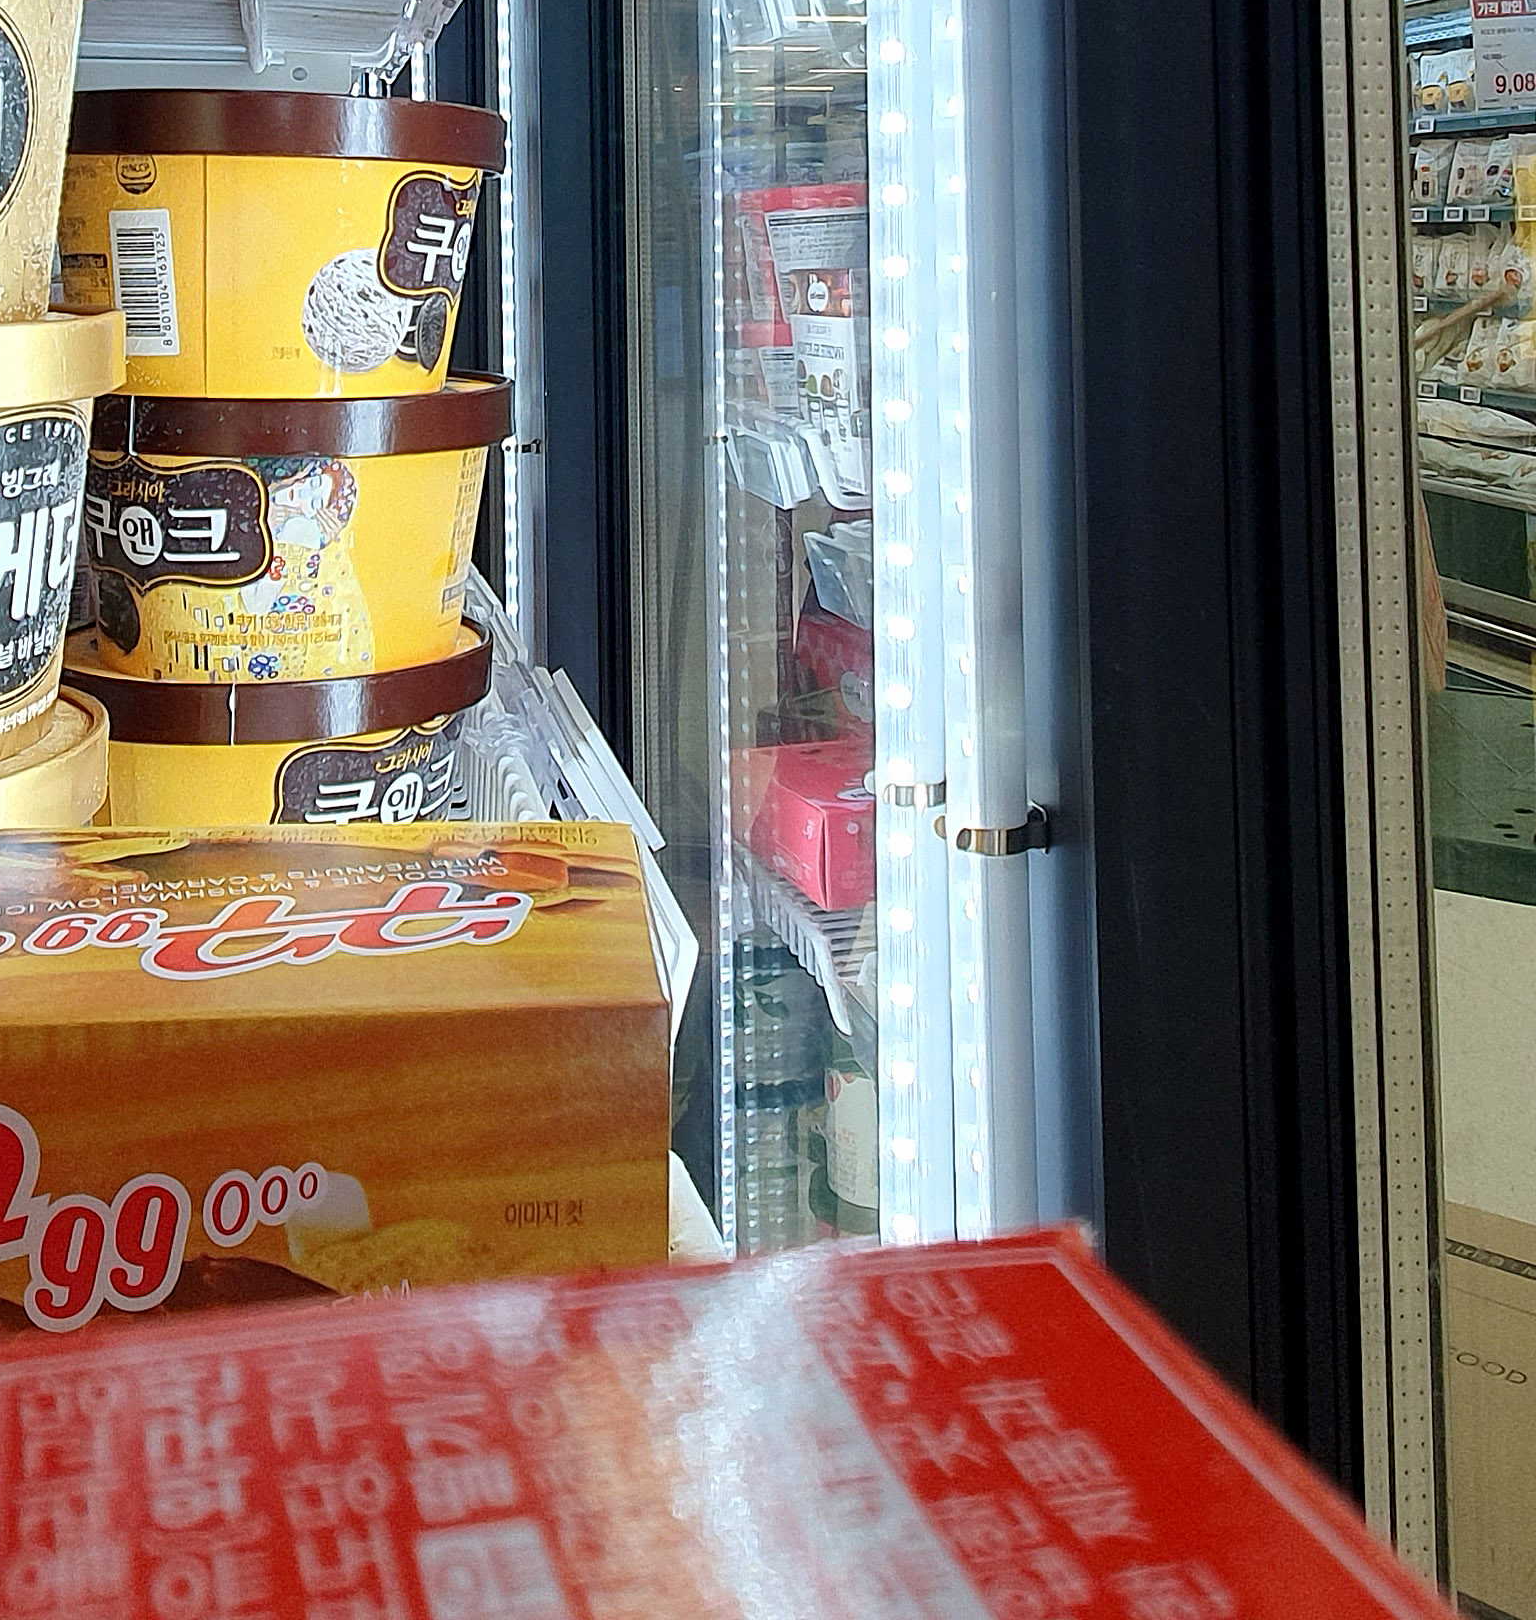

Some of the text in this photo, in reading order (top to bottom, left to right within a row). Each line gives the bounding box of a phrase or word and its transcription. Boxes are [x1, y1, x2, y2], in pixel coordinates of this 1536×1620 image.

[85, 493, 241, 566] 쿠앤크
[304, 749, 456, 824] 쿠앤크
[329, 865, 509, 889] CHOCOLATE
[434, 853, 502, 871] WITH
[47, 881, 294, 914] MARSHMALLOW
[98, 876, 250, 898] CARAMEL
[504, 1198, 584, 1229] 이미지 컷
[30, 1180, 186, 1325] 99
